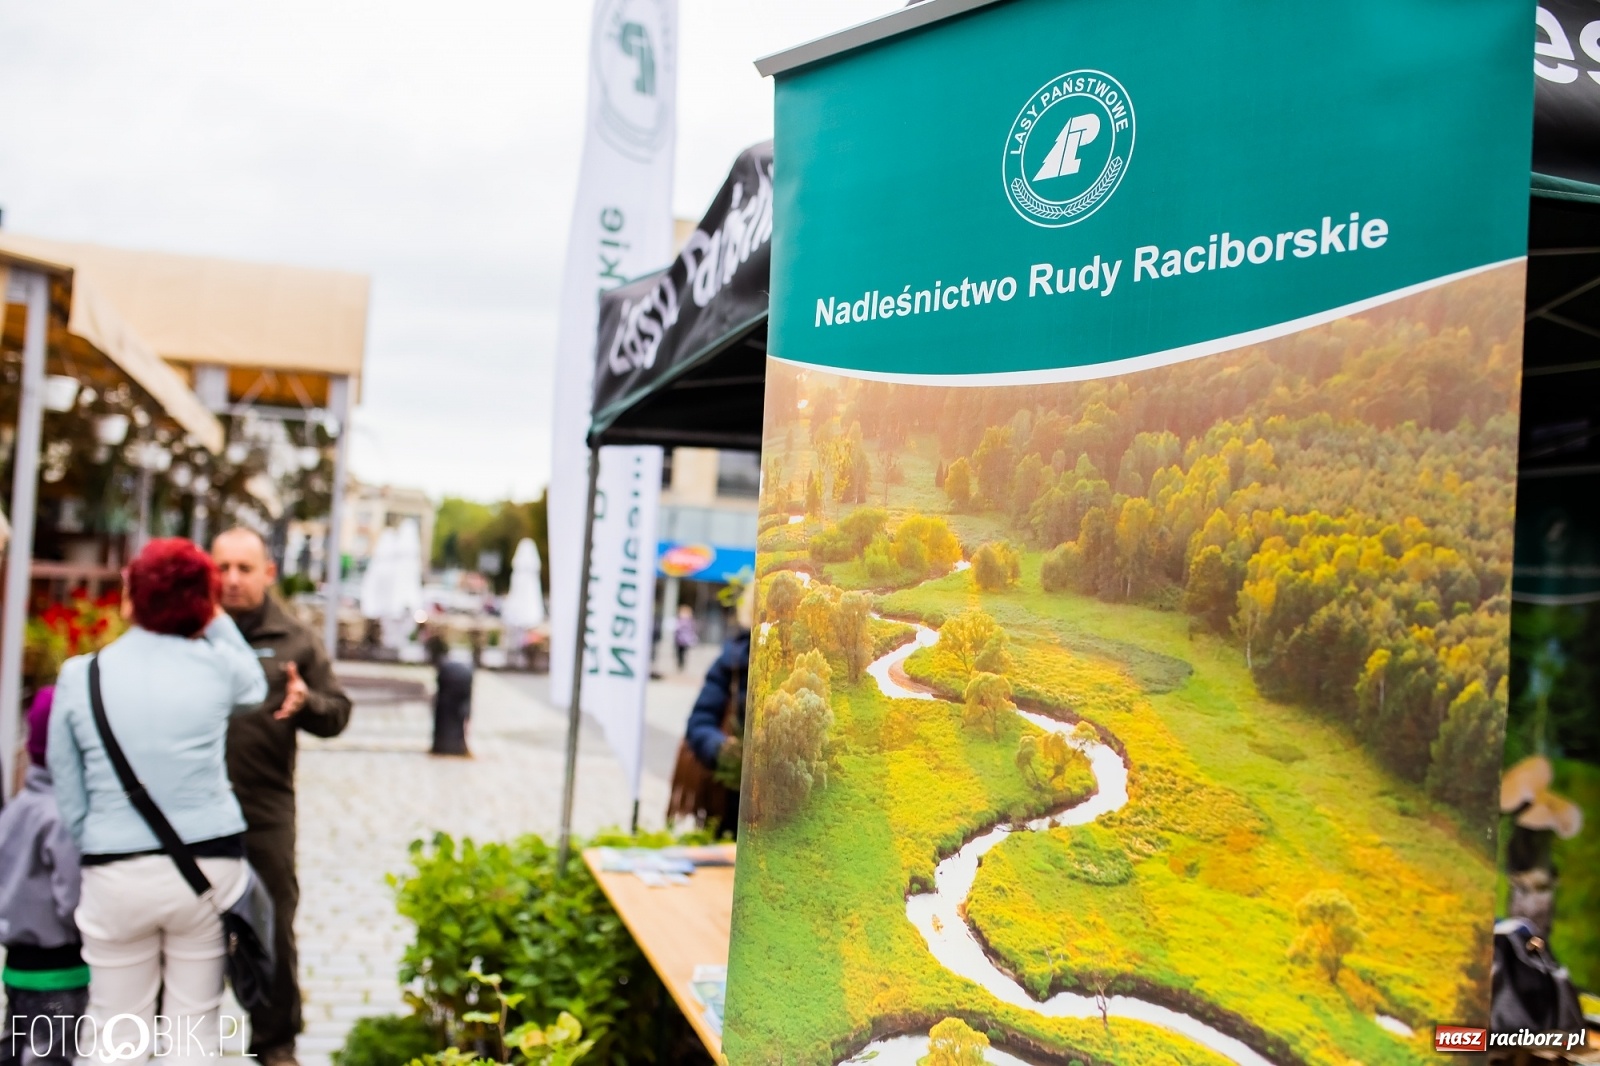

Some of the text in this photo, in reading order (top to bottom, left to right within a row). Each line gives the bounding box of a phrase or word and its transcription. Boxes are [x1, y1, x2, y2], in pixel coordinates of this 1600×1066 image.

[1010, 77, 1129, 155] LASY PAŃSTWOWE
[815, 212, 1389, 327] Nadleśnictwo Rudy Raciborskie
